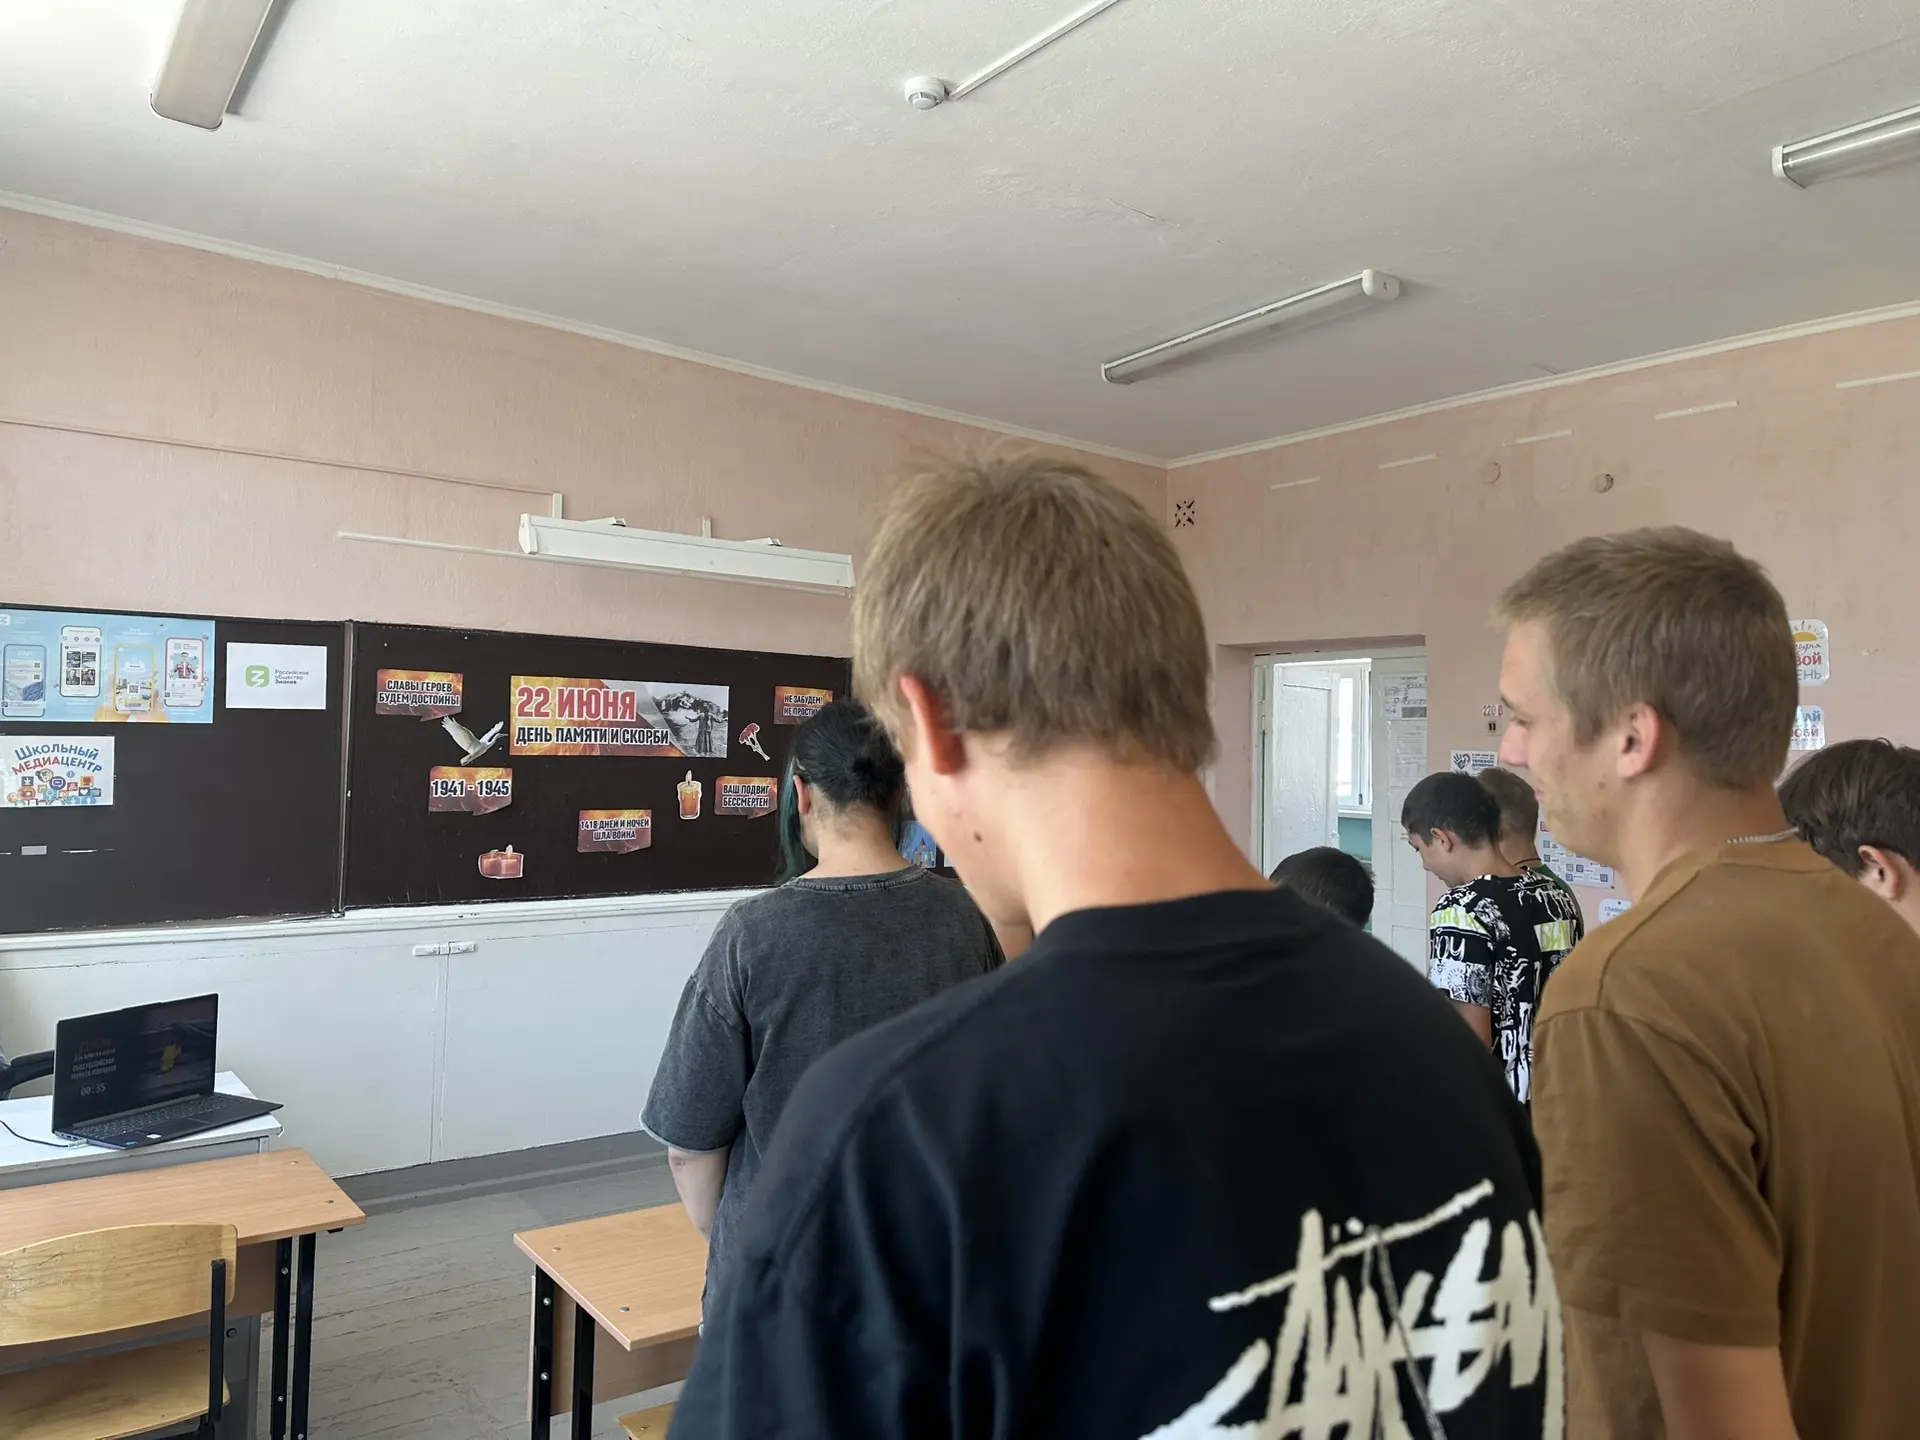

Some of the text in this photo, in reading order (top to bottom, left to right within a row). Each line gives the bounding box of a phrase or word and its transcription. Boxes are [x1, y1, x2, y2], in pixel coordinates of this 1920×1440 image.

[1796, 652, 1821, 666] ВОЙ
[1797, 669, 1821, 680] ЕНЬ
[387, 680, 452, 692] СЛАВЫ ГЕРОЕВ
[379, 692, 459, 706] БУДЕМ ДОСТОЙНЫ
[517, 687, 636, 721] 22 ИЮНЯ
[784, 694, 793, 703] НЕ
[783, 707, 792, 716] НЕ
[515, 727, 669, 745] ДЕНЬ ПАМЯТИ И СКОРБИ
[14, 744, 99, 761] ШКОЛЬНЫЙ
[11, 756, 102, 775] МЕДИАЦЕНТР
[432, 780, 464, 796] 1941
[477, 780, 510, 796] 1945
[723, 785, 770, 795] ВАШ ПОДВИГ
[723, 797, 768, 807] БЕССМЕРТЕН
[580, 820, 597, 829] 1418
[599, 819, 619, 829] ДНЕЙ
[626, 817, 649, 828] НОЧЕЙ
[594, 829, 635, 840] ШЛА ВОЙНА
[80, 1083, 106, 1096] 00:35
